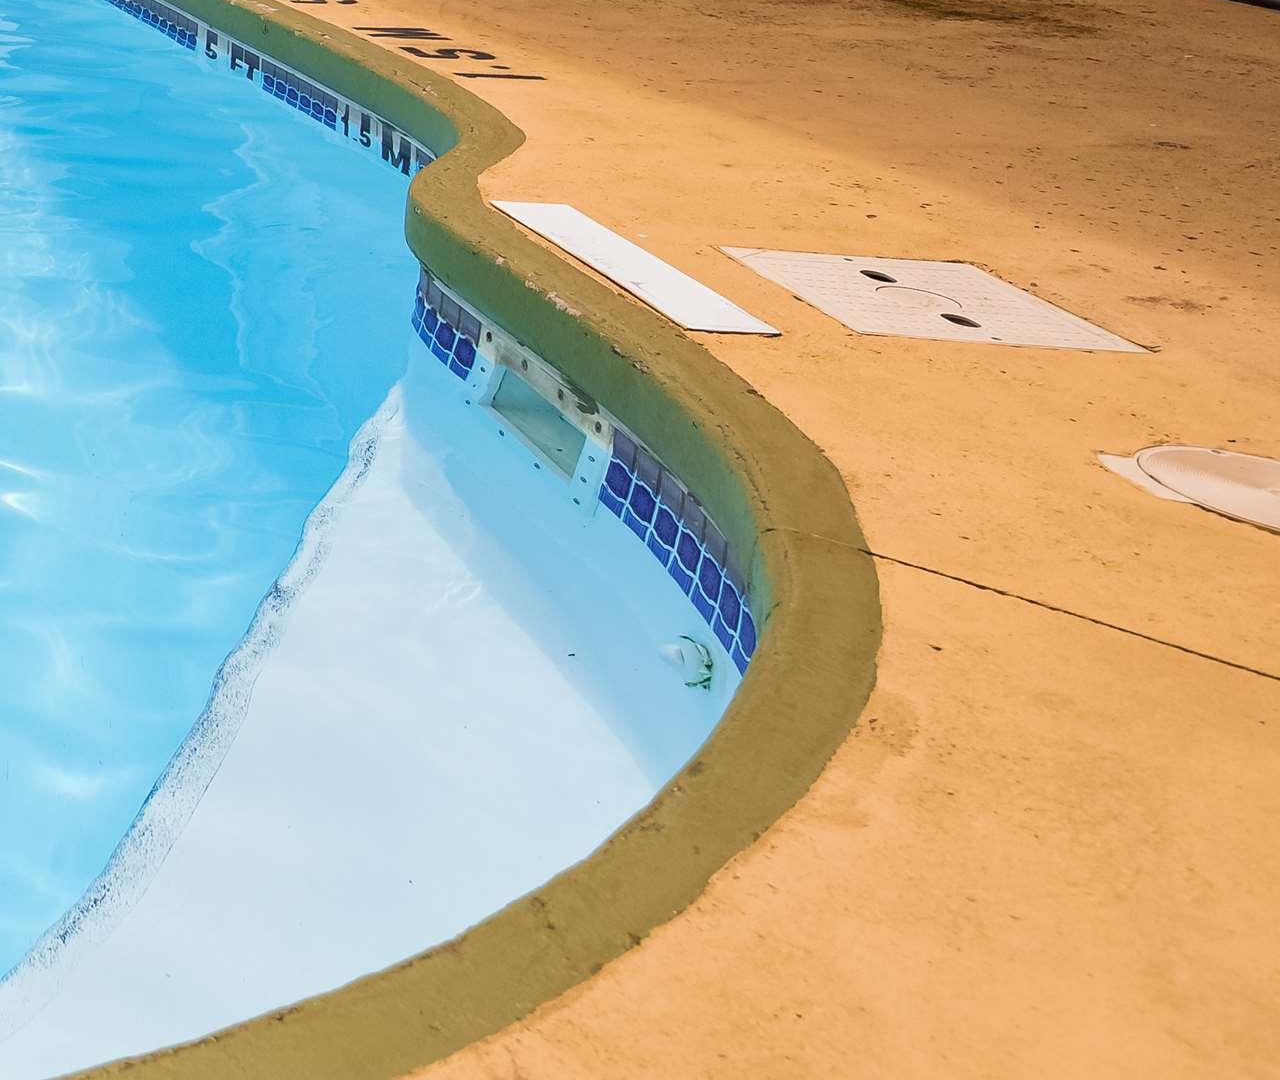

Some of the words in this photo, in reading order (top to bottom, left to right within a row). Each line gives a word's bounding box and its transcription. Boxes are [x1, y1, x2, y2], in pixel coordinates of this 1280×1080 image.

[205, 28, 218, 61] 5
[230, 42, 259, 82] FT
[353, 26, 453, 41] M
[341, 104, 371, 148] 1.5
[381, 123, 411, 177] M
